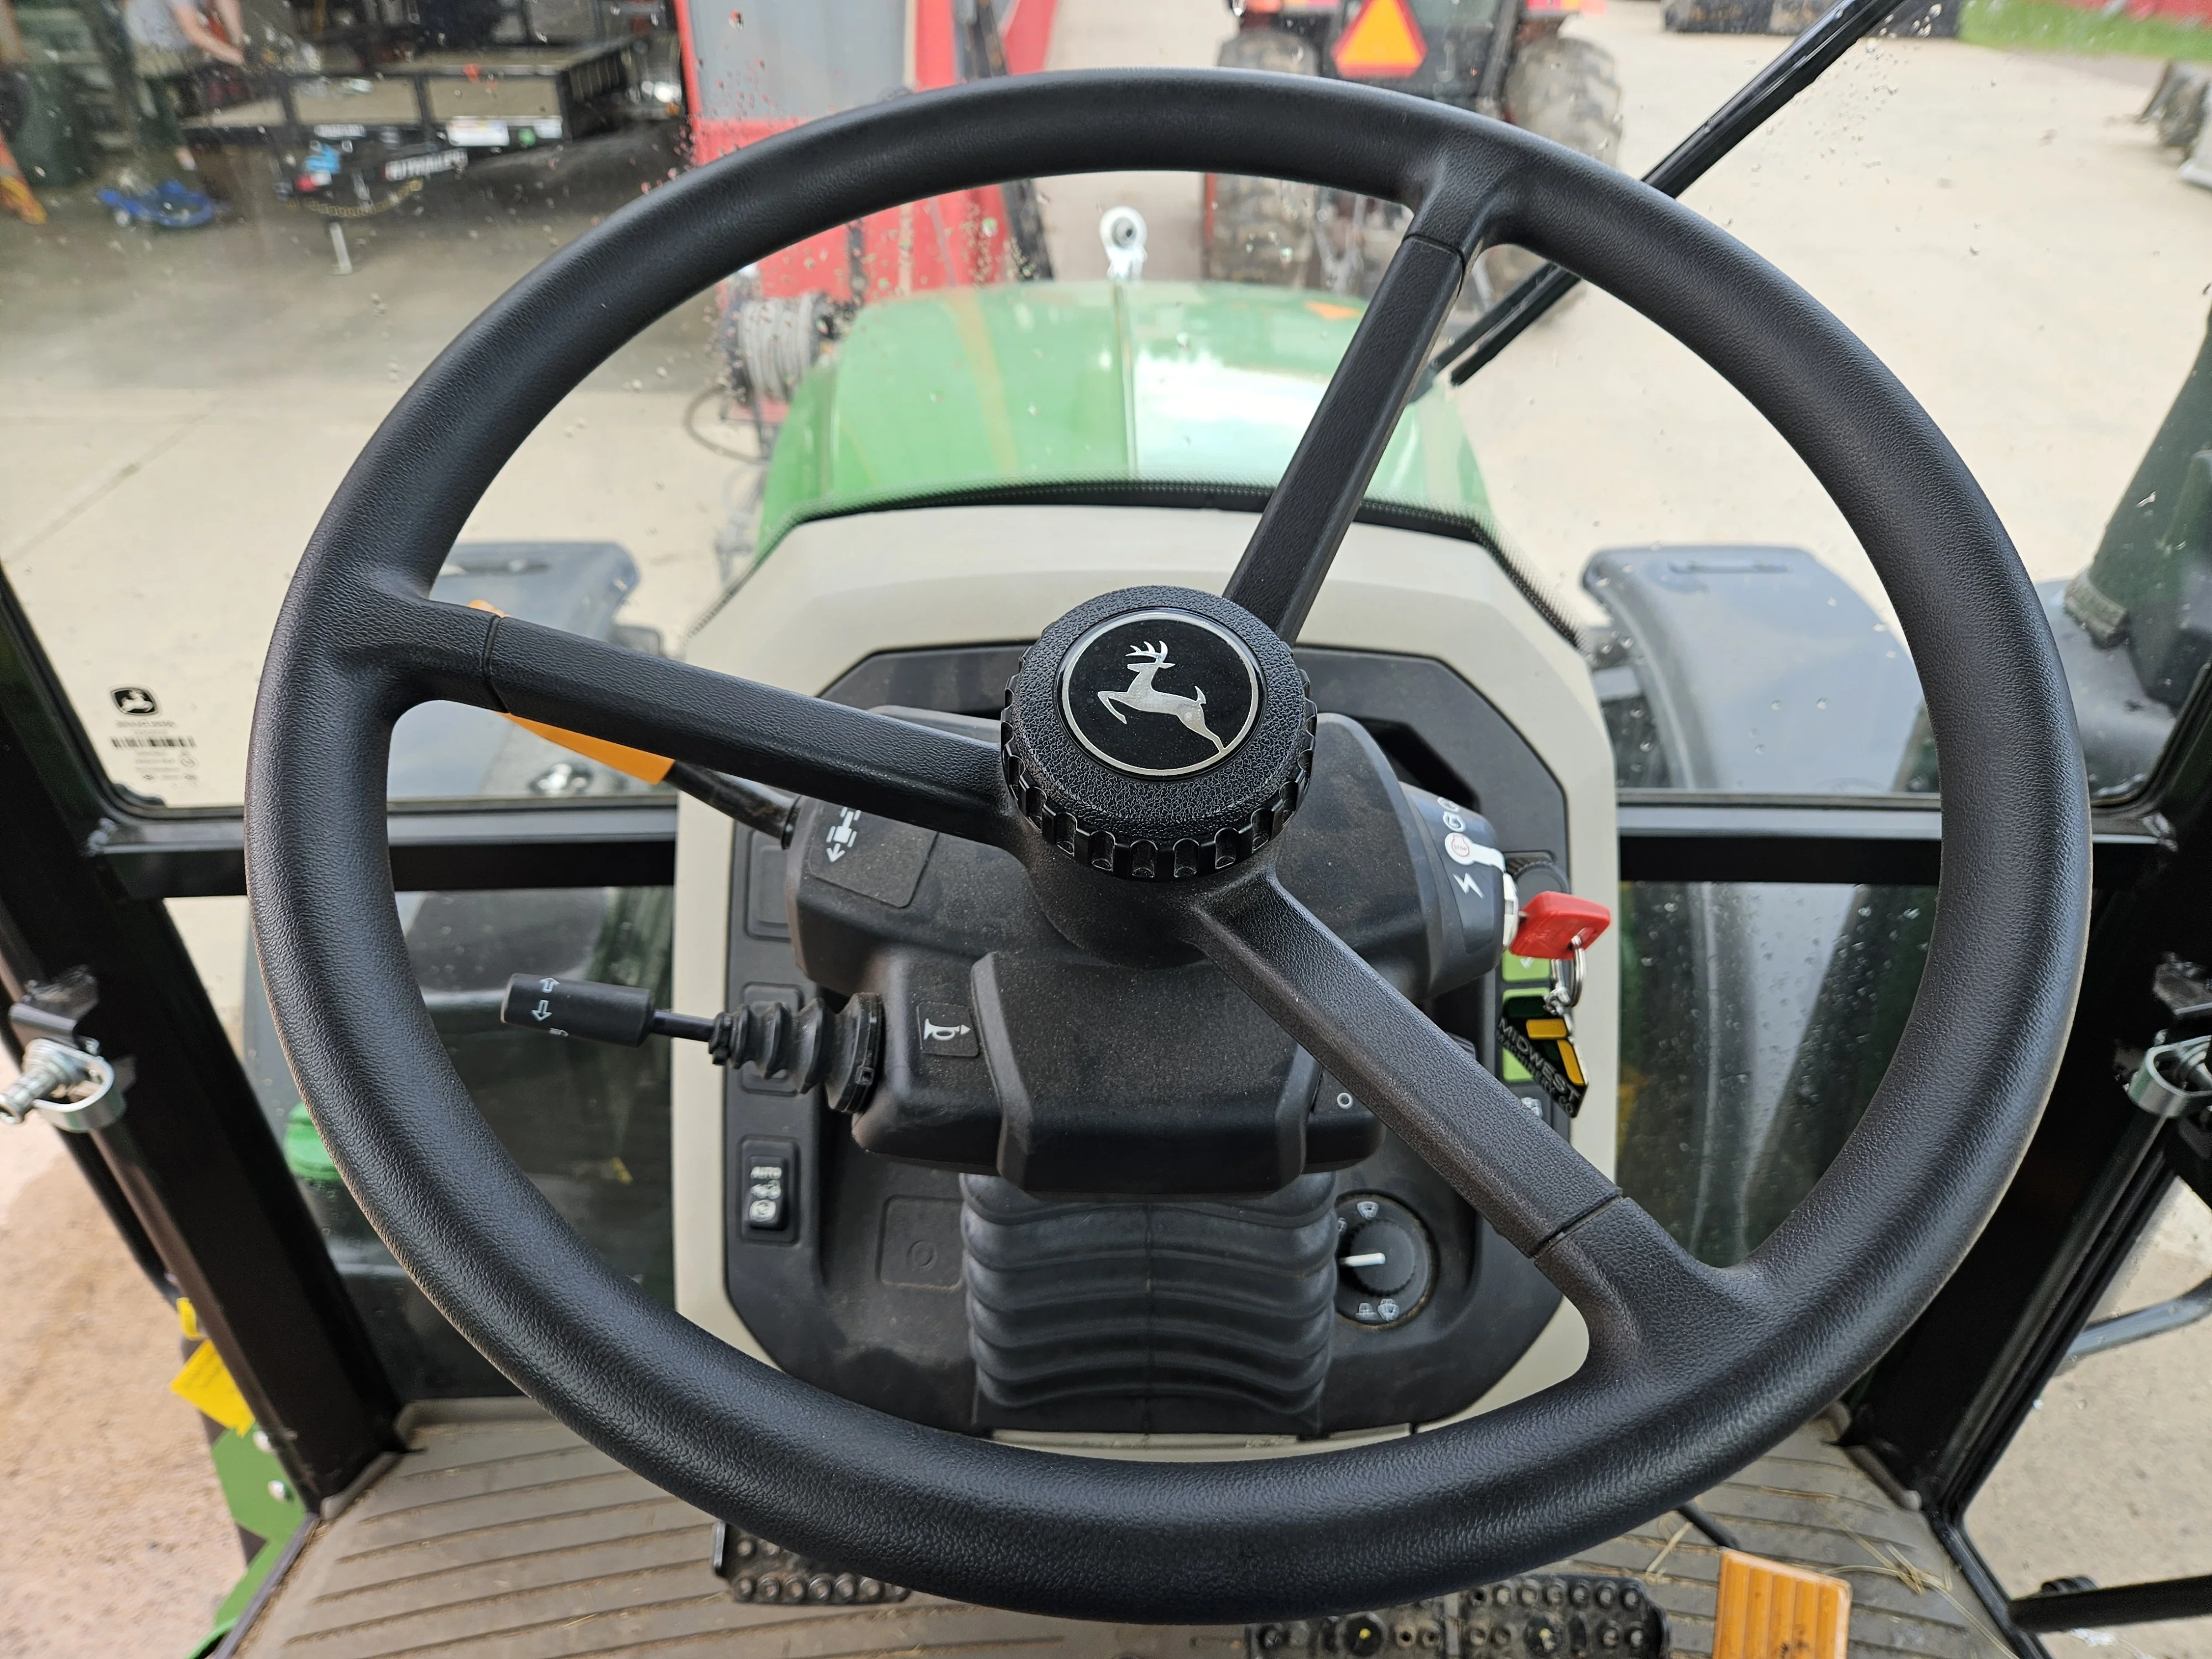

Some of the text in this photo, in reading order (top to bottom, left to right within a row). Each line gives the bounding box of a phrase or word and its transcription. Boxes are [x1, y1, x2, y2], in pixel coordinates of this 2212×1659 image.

[1497, 1030, 1556, 1093] MACHINERY
[1499, 1018, 1582, 1102] MIDWEST
[750, 1166, 782, 1179] AUTO
